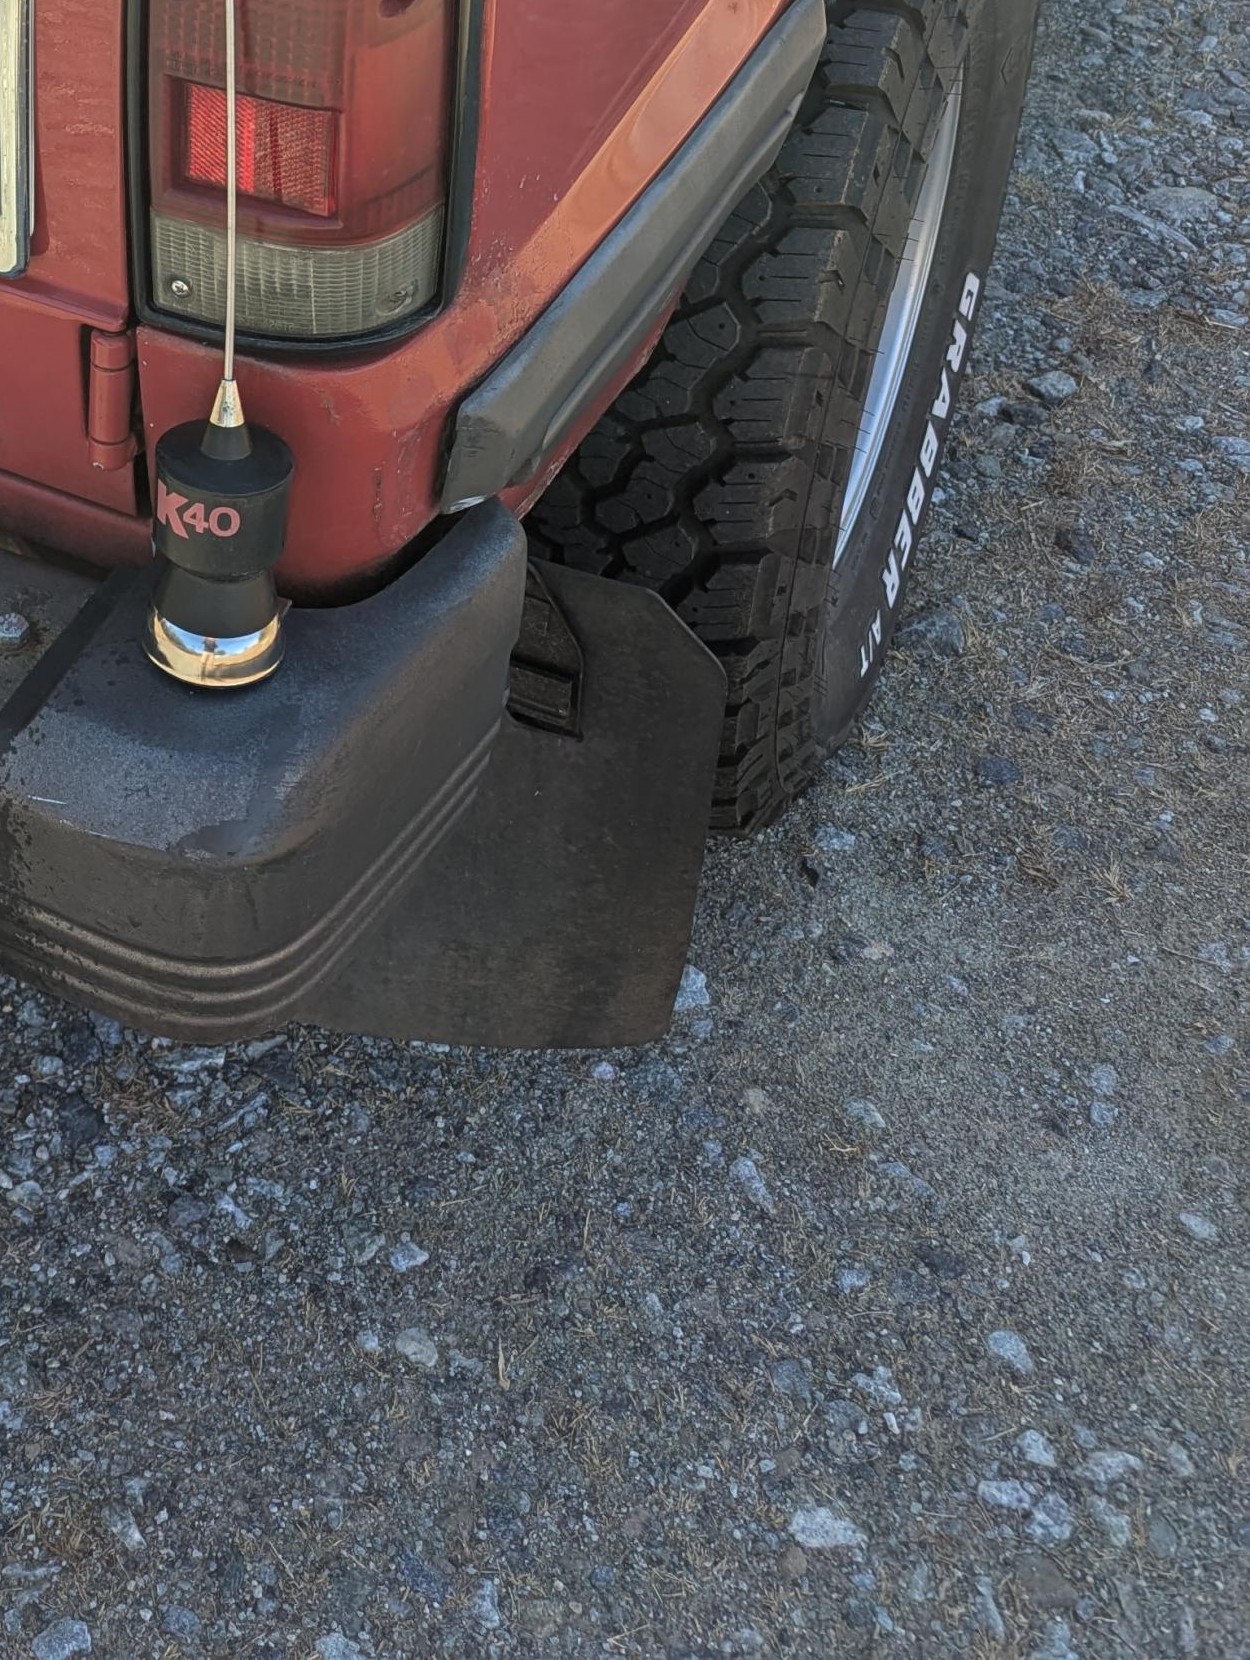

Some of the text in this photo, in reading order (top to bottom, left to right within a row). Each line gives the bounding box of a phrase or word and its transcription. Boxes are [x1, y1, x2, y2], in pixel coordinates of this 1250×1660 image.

[882, 271, 980, 610] GRABBER
[157, 479, 241, 541] K40
[859, 609, 882, 679] A/T
